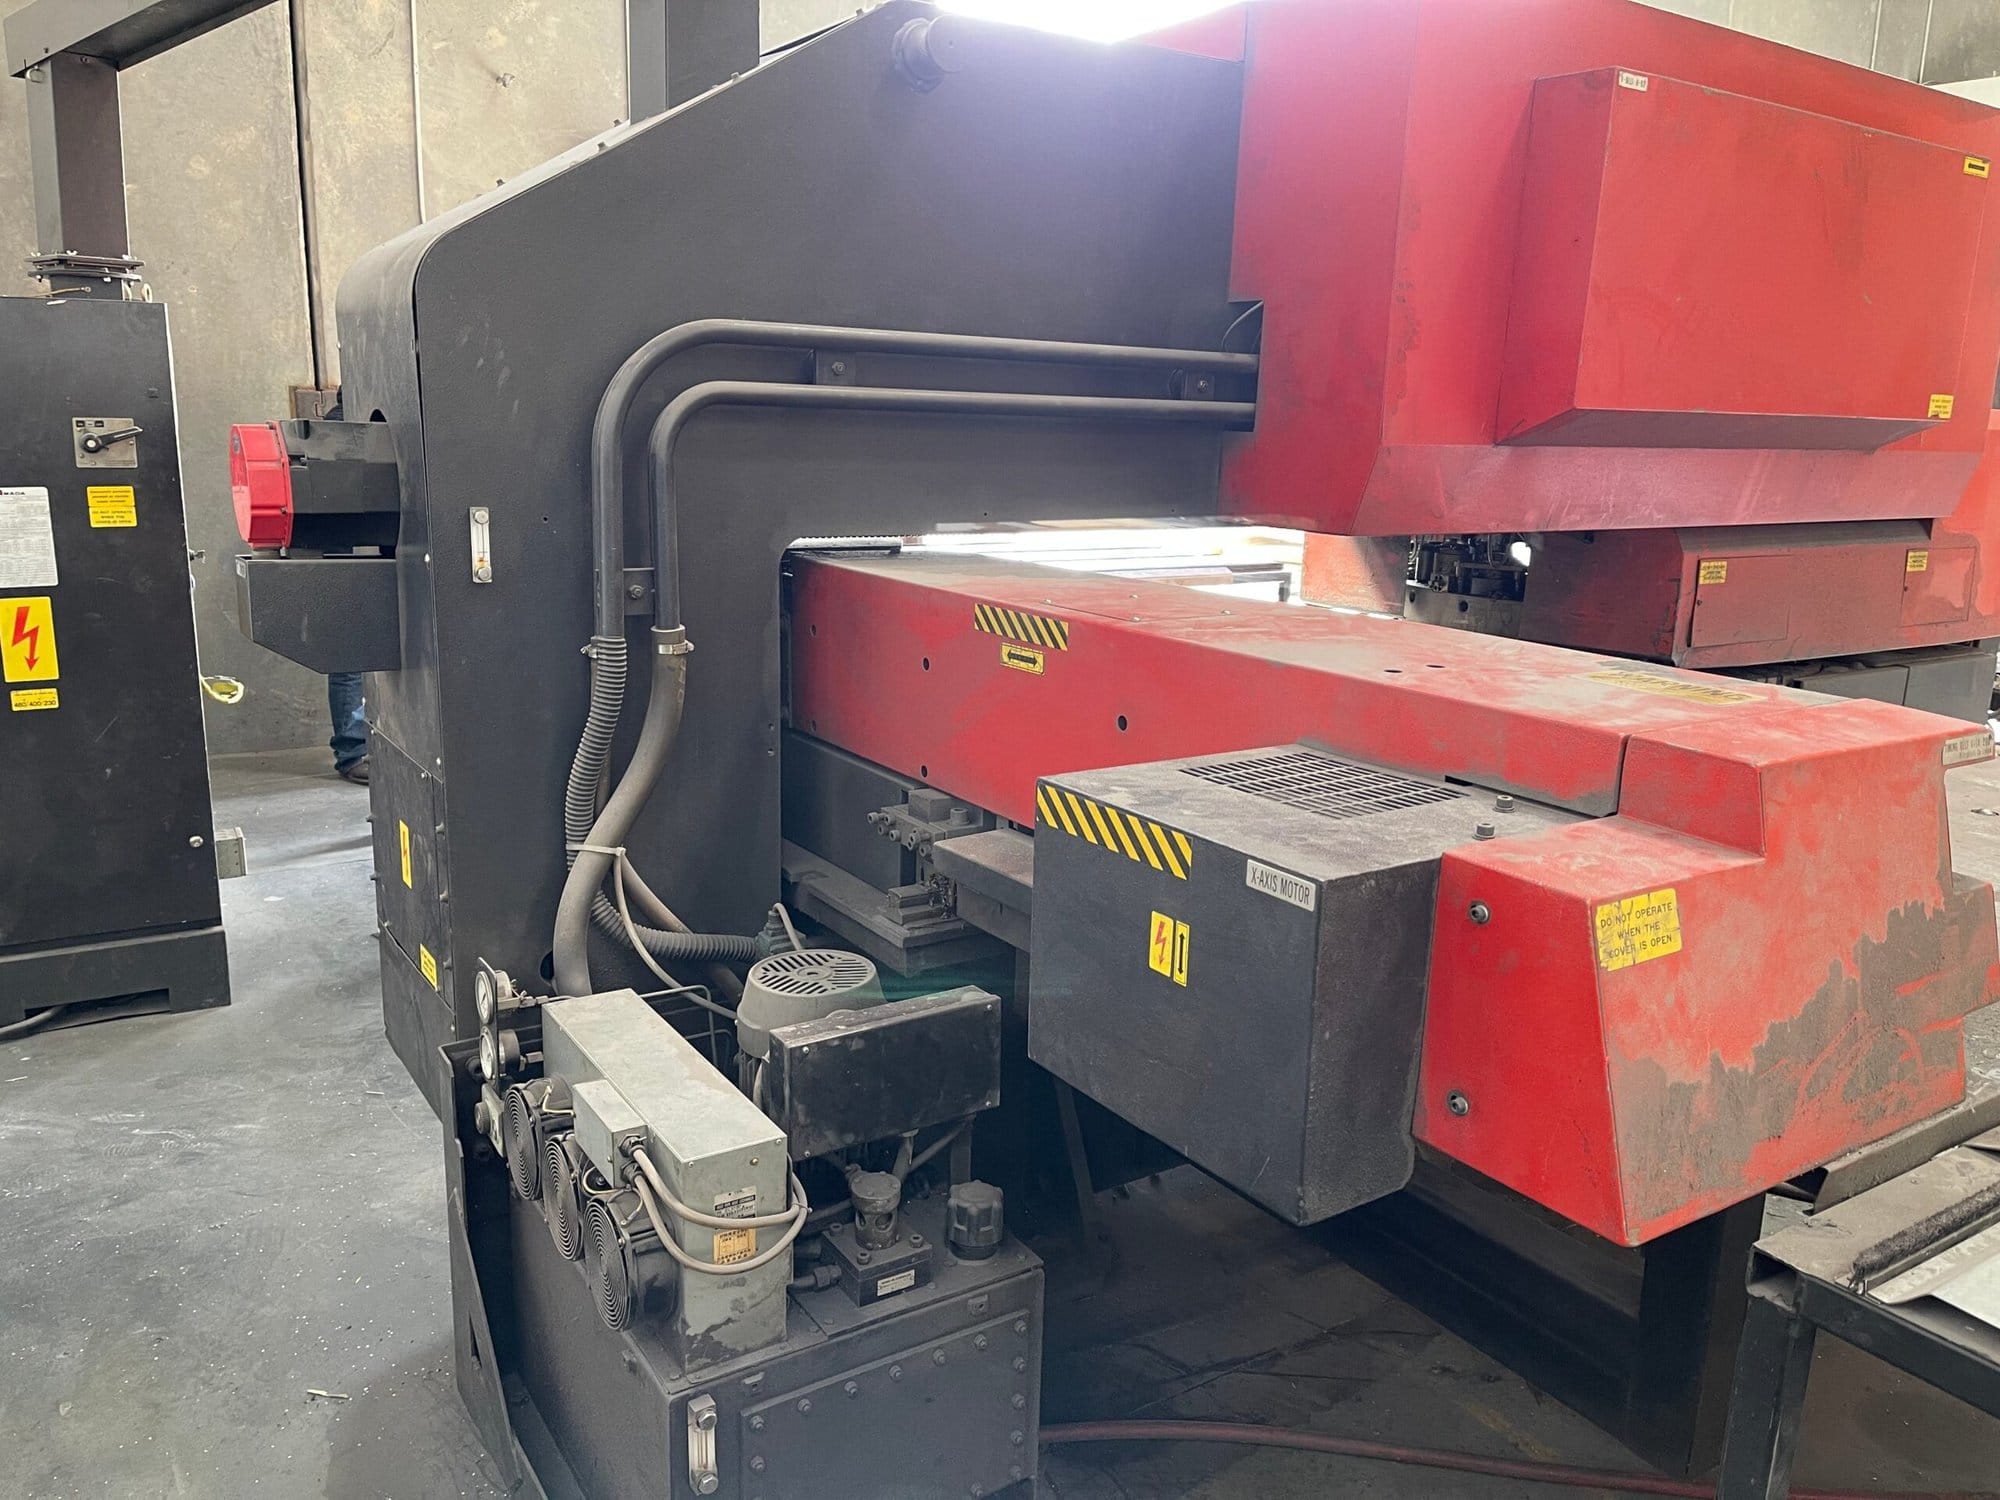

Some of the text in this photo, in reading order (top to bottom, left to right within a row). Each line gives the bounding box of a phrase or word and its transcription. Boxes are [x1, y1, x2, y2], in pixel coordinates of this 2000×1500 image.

[1250, 867, 1310, 905] X-AXIS MOTOR
[1600, 902, 1673, 928] DO NOT OPERATE
[1617, 921, 1661, 940] WHEN THE
[1609, 934, 1672, 959] COVER IS OPEN
